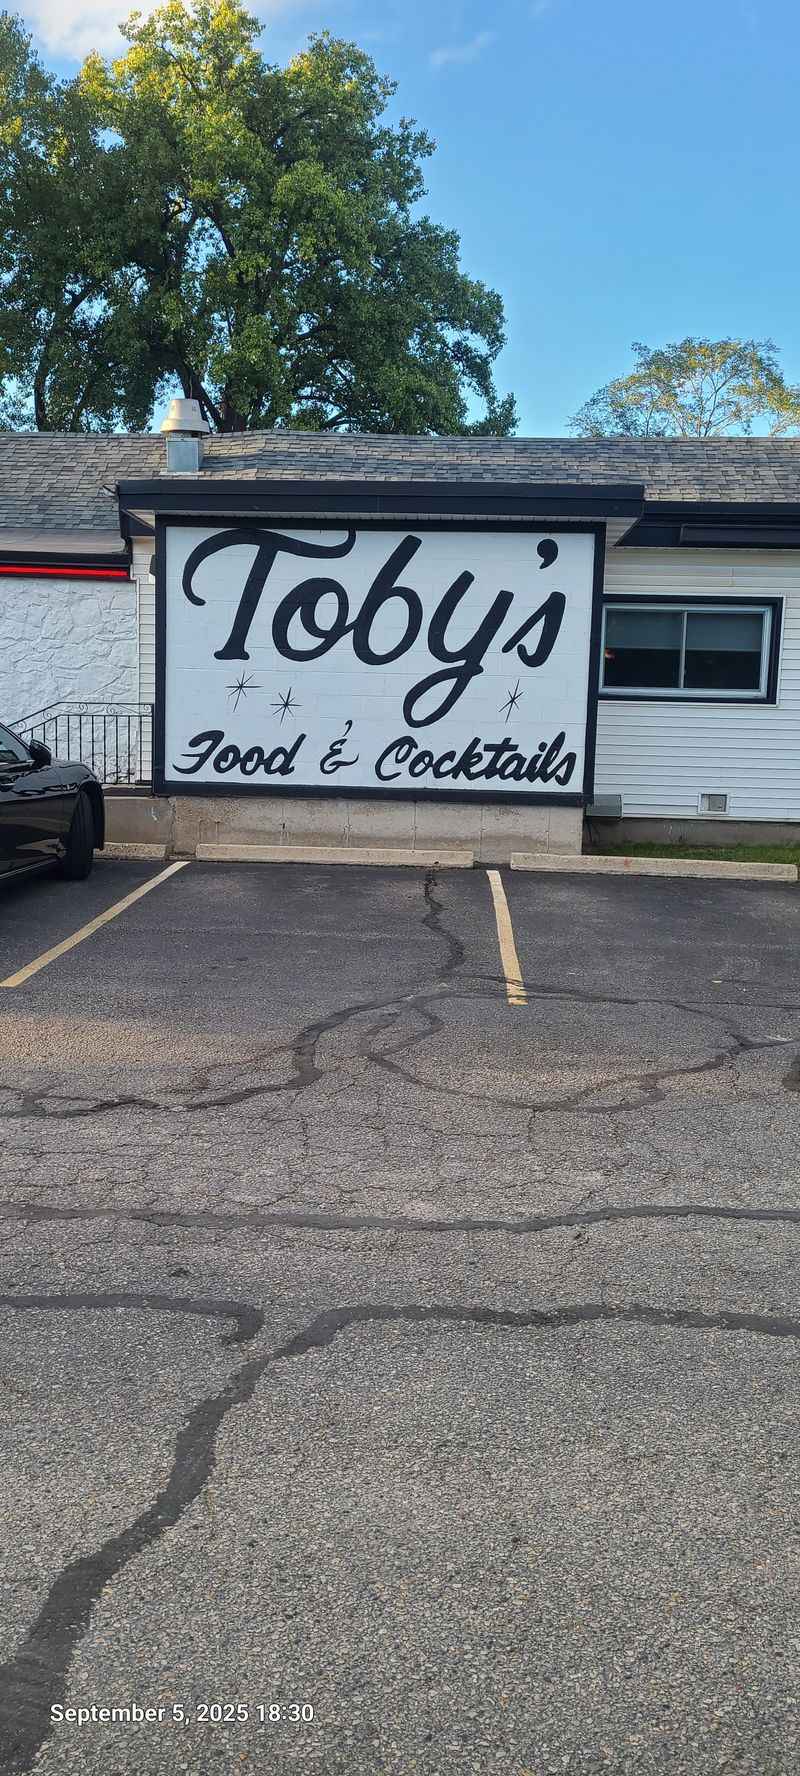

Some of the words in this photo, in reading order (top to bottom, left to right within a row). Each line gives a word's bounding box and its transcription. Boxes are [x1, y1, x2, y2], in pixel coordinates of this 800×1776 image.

[182, 528, 567, 728] Toby's
[173, 730, 306, 776] Food
[320, 720, 359, 775] &
[375, 731, 577, 787] Cocktails
